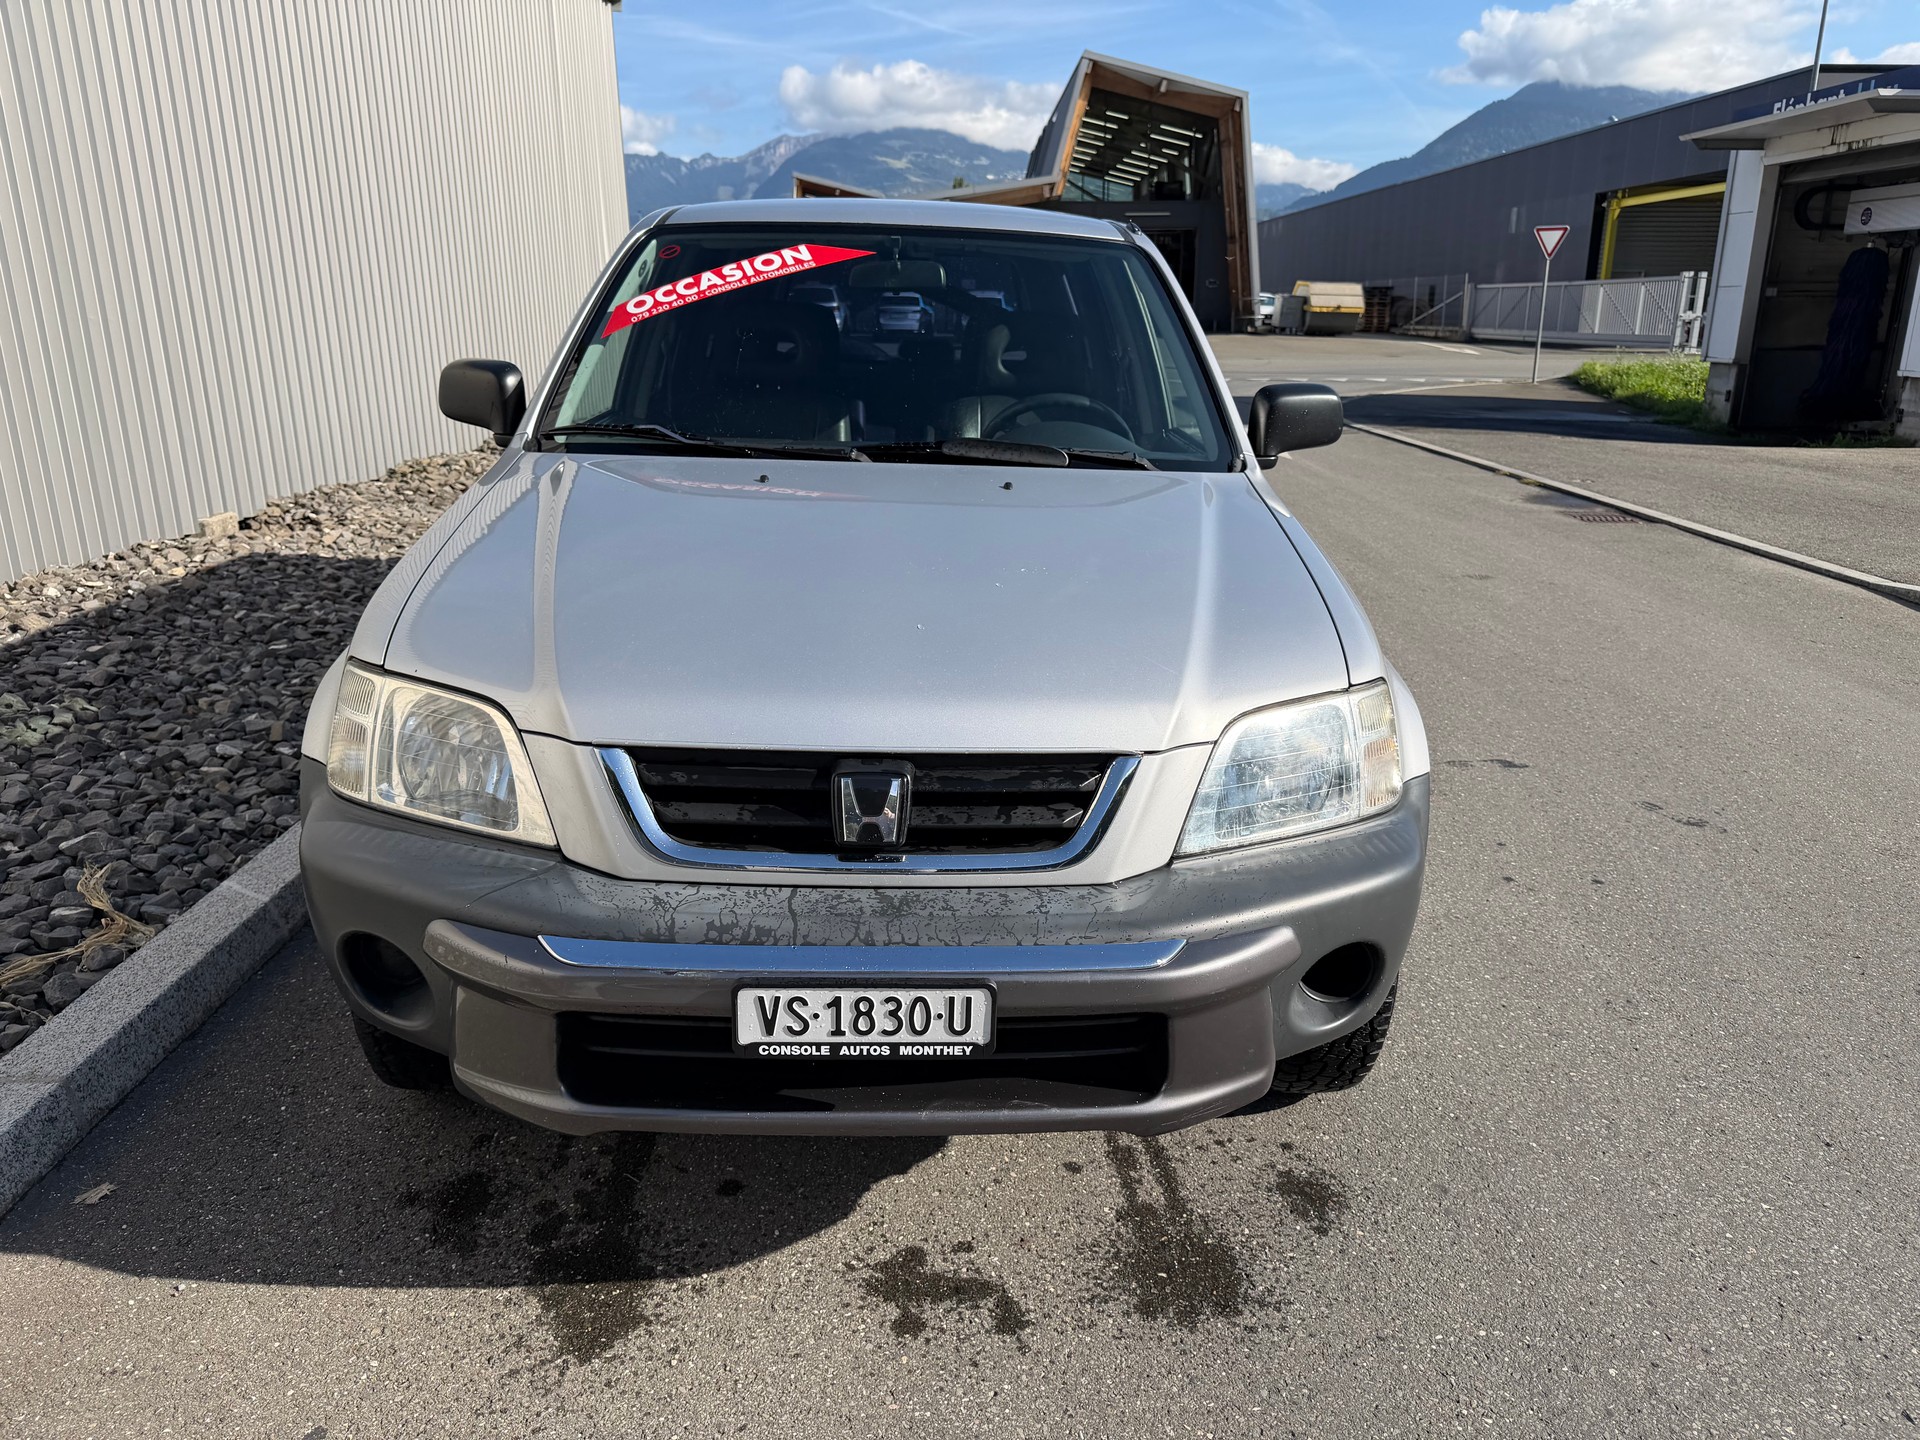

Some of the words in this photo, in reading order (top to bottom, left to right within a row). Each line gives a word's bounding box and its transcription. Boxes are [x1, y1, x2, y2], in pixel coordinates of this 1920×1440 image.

[626, 244, 813, 314] OCCASION
[631, 312, 650, 323] 079
[651, 304, 670, 315] 220
[671, 299, 684, 307] 40
[685, 294, 699, 303] 00
[705, 279, 748, 297] CONSOLE
[750, 261, 816, 284] AUTOMOBILES
[758, 1044, 831, 1056] CONSOLE
[839, 1044, 891, 1056] AUTOS
[899, 1044, 974, 1056] MONTHEY
